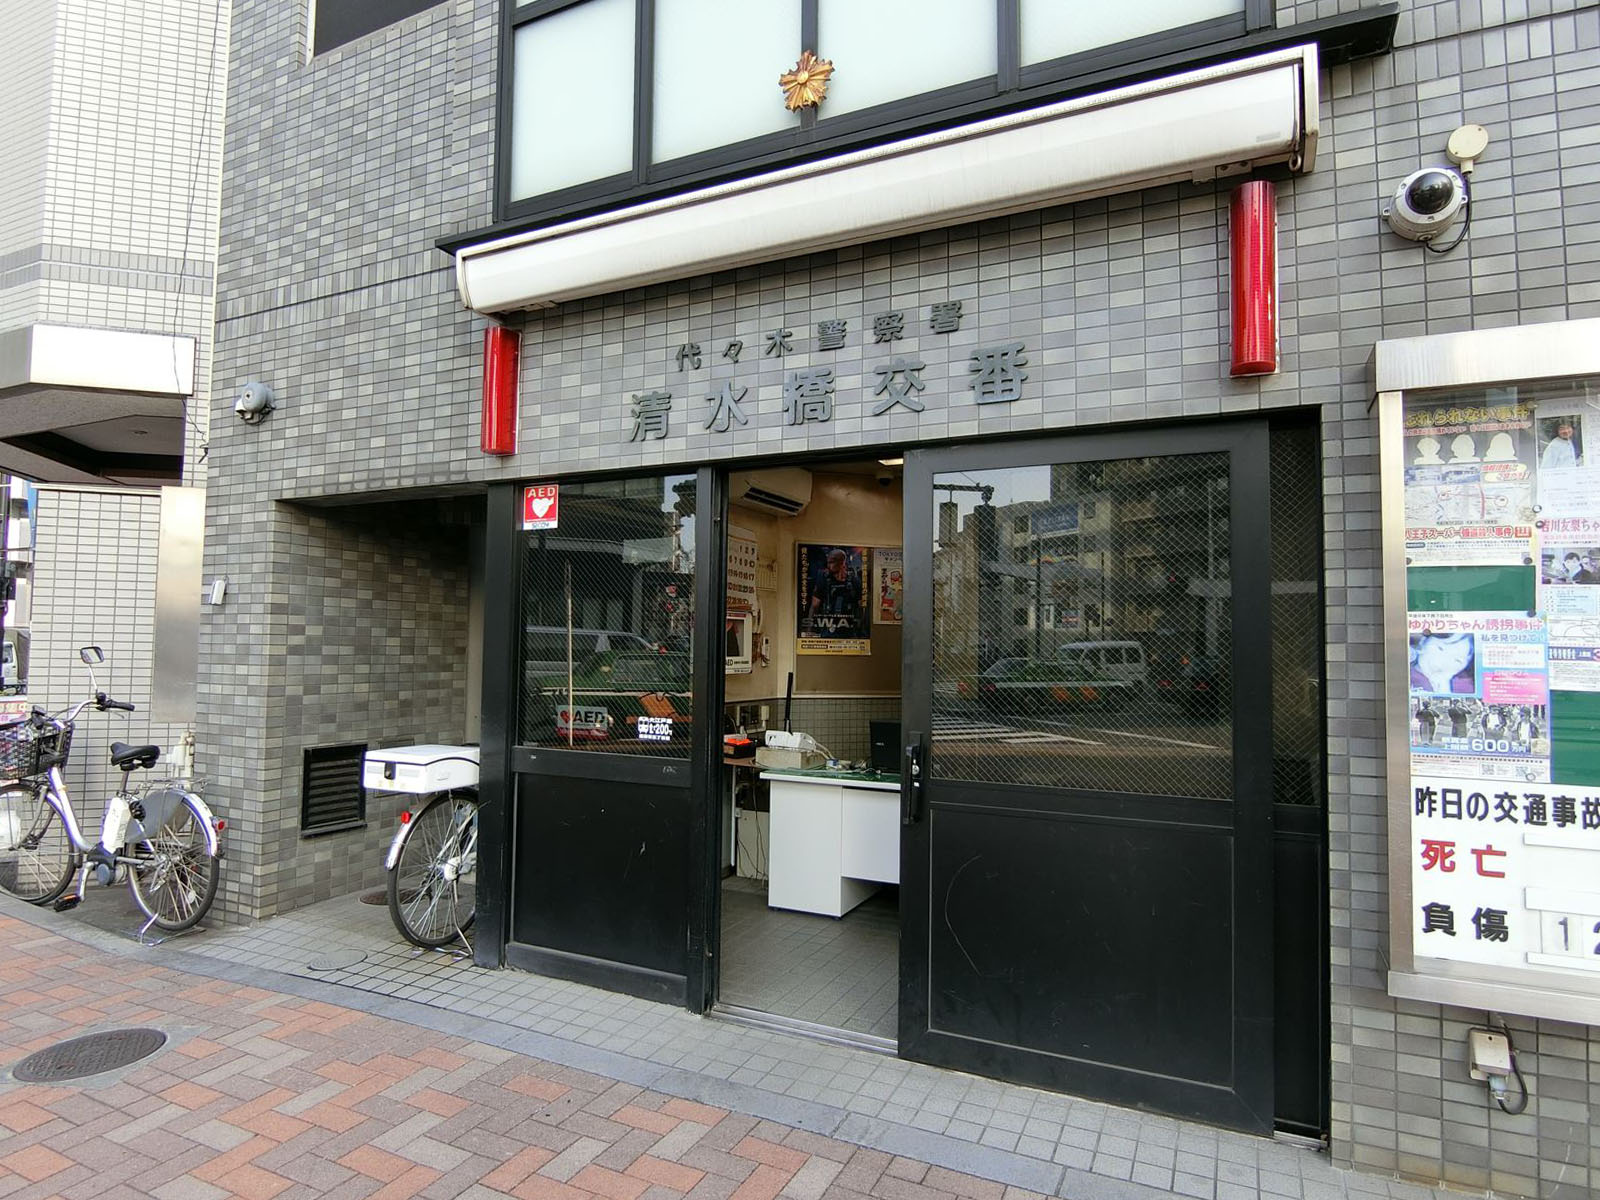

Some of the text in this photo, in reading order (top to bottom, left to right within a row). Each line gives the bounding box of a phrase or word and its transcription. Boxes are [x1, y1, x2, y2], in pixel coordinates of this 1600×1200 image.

[676, 300, 963, 372] 代々木警察署
[630, 341, 1029, 442] 清水橋交番
[528, 487, 556, 498] AED
[1409, 619, 1543, 631] ゆかりちゃん誘拐事件
[573, 711, 605, 724] AED
[1471, 739, 1509, 752] 600
[1415, 786, 1600, 830] 昨日の交通事故
[1420, 839, 1507, 879] 死亡
[1421, 902, 1509, 943] 負傷
